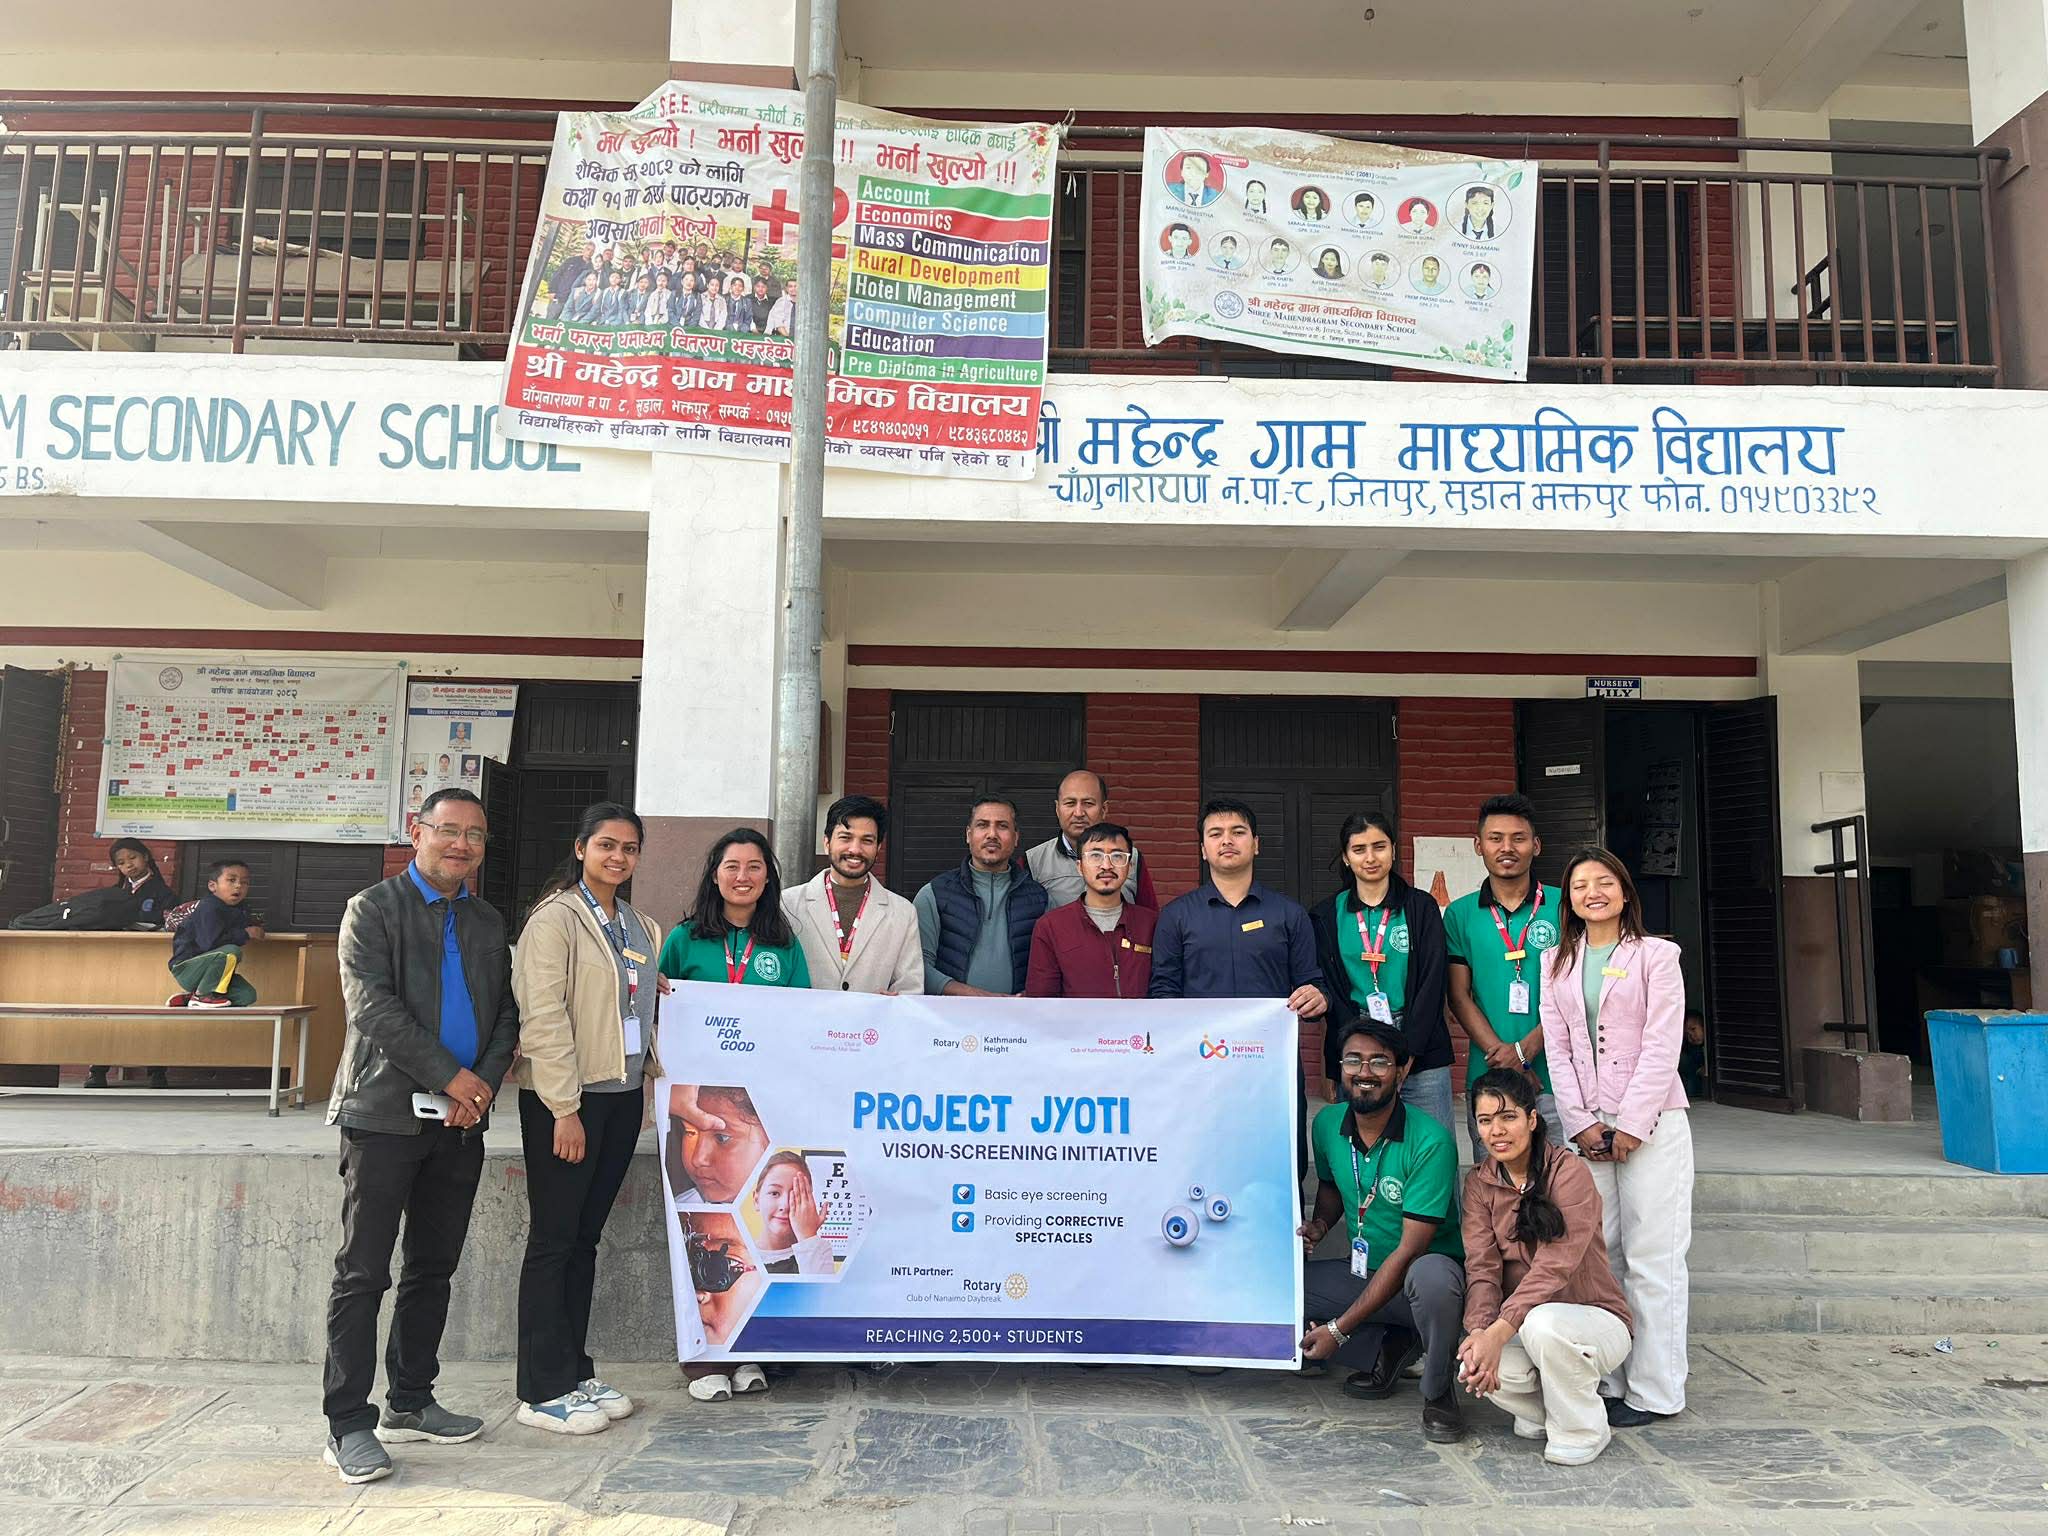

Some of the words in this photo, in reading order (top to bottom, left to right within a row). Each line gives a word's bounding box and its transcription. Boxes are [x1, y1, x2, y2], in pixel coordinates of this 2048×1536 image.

[660, 93, 693, 117] S.E.E.
[718, 123, 762, 155] भर्ना
[876, 142, 921, 175] भर्ना
[926, 151, 988, 186] खुल्यो
[576, 158, 619, 184] शैक्षिक
[640, 159, 674, 178] २०८२
[678, 158, 701, 177] को
[706, 161, 746, 185] लागि
[562, 186, 599, 210] कक्षा
[602, 191, 621, 211] ११
[624, 186, 640, 208] मा
[671, 184, 752, 212] पाठ्यक्रम
[862, 179, 931, 207] Account
[585, 217, 638, 244] अनुसार
[638, 211, 666, 238] भर्ना
[670, 214, 718, 245] खुल्यो
[861, 204, 953, 232] Economics
[859, 224, 905, 249] Mass
[911, 230, 1041, 263] Communication
[857, 249, 904, 276] Rural
[910, 262, 1021, 288] Development
[855, 274, 900, 301] Hotel
[907, 283, 1017, 311] Management
[853, 301, 936, 330] Computer
[941, 312, 1009, 332] Science
[1247, 296, 1261, 308] श्री
[1263, 298, 1296, 313] महेन्द्र
[1298, 302, 1321, 314] ग्राम
[1322, 304, 1373, 322] माध्यमिक
[1376, 309, 1417, 326] विद्यालय
[531, 320, 565, 345] भर्ना
[567, 328, 613, 351] फारम
[617, 330, 667, 350] धमाधम
[671, 329, 728, 355] वितरण
[850, 326, 936, 354] Education
[848, 356, 873, 375] Pre
[878, 359, 937, 378] Diploma
[941, 363, 955, 377] in
[959, 363, 1039, 383] Agriculture
[524, 352, 568, 382] श्री
[574, 359, 663, 391] महेन्द्र
[671, 366, 735, 392] ग्राम
[907, 383, 1031, 417] विद्यालय
[521, 383, 584, 409] चाँगुनारायण
[671, 399, 712, 420] भक्तपुर,
[718, 401, 750, 422] सम्पर्क
[46, 394, 356, 467] SECONDARY
[518, 409, 604, 434] विद्यार्थीहरुको
[610, 418, 669, 439] सुविधाको
[675, 422, 713, 441] लागि
[718, 425, 792, 449] विद्यालयमा
[859, 441, 913, 460] व्यवस्था
[919, 446, 945, 462] पनि
[951, 450, 988, 467] रहेको
[996, 454, 1012, 468] छ
[1078, 403, 1224, 468] महेन्द्र
[1249, 420, 1366, 475] ग्राम
[1397, 406, 1639, 474] माध्यमिक
[1652, 406, 1845, 476] विद्यालय
[16, 466, 47, 490] B.S.
[1048, 466, 1211, 511] चाँगुनारायण
[1440, 480, 1525, 517] सुडाल
[1640, 475, 1710, 514] फोन.
[1593, 679, 1634, 688] NURSERY
[1595, 688, 1633, 698] LILY
[704, 1015, 740, 1028] UNITE
[717, 1028, 742, 1040] FOR
[720, 1040, 756, 1053] GOOD
[827, 1029, 861, 1040] Rotaract
[933, 1037, 960, 1049] Rotary
[983, 1035, 1028, 1045] Kathmandu
[1097, 1037, 1128, 1046] Rotaract
[983, 1045, 1009, 1055] Height
[853, 1090, 1012, 1133] PROJECT
[1030, 1095, 1130, 1135] JYOTI
[882, 1142, 1058, 1162] VISION-SCREENING
[1061, 1145, 1158, 1163] INITIATIVE
[832, 1162, 844, 1177] E
[984, 1188, 1019, 1201] Basic
[1021, 1191, 1043, 1204] eye
[1045, 1190, 1108, 1205] screening
[984, 1214, 1042, 1230] Providing
[1045, 1215, 1124, 1228] CORRECTIVE
[1015, 1231, 1093, 1244] SPECTACLES
[891, 1266, 912, 1277] INTL
[913, 1266, 954, 1277] Partner:
[963, 1279, 1002, 1293] Rotary
[906, 1293, 922, 1303] Club
[923, 1294, 932, 1303] of
[967, 1294, 1002, 1305] Daybreak
[865, 1329, 945, 1344] REACHING
[949, 1329, 1002, 1346] 2,500+
[1007, 1330, 1084, 1344] STUDENTS
